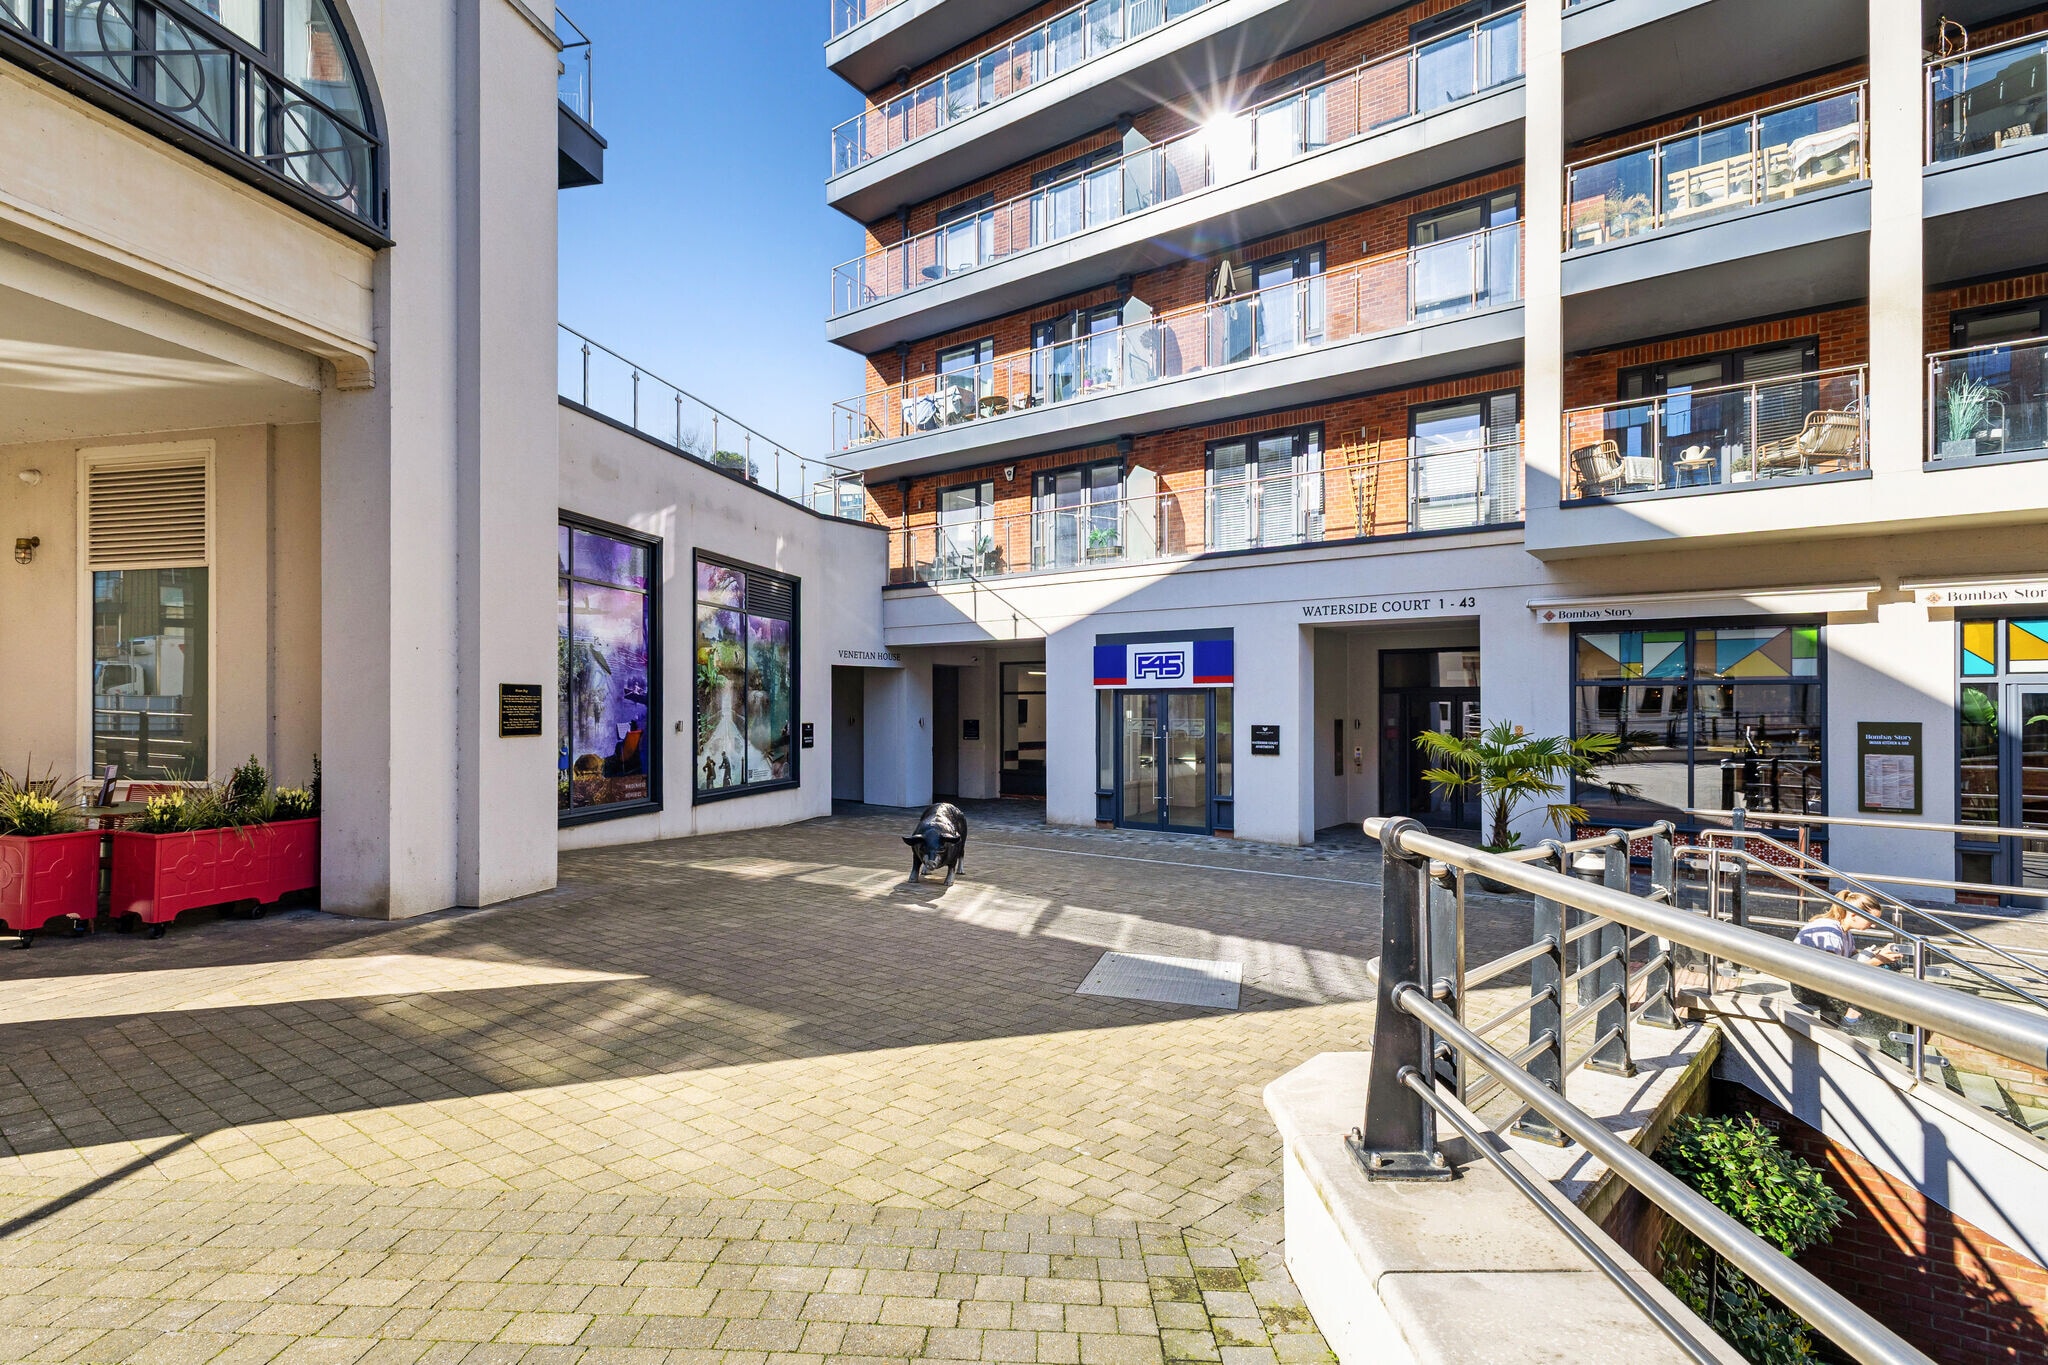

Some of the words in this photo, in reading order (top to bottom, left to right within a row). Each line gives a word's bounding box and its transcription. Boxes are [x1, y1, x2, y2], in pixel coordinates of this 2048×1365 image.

[1947, 590, 2008, 601] Bombay
[2014, 588, 2048, 598] Stor
[1302, 602, 1378, 617] WATERSIDE
[1381, 599, 1431, 613] COURT
[1439, 598, 1445, 609] 1
[1458, 597, 1476, 608] 43
[1558, 609, 1602, 619] Bombay
[1604, 607, 1633, 617] Story
[838, 650, 876, 660] VENETIAN
[877, 652, 902, 661] HOUSE
[1134, 651, 1185, 679] F45
